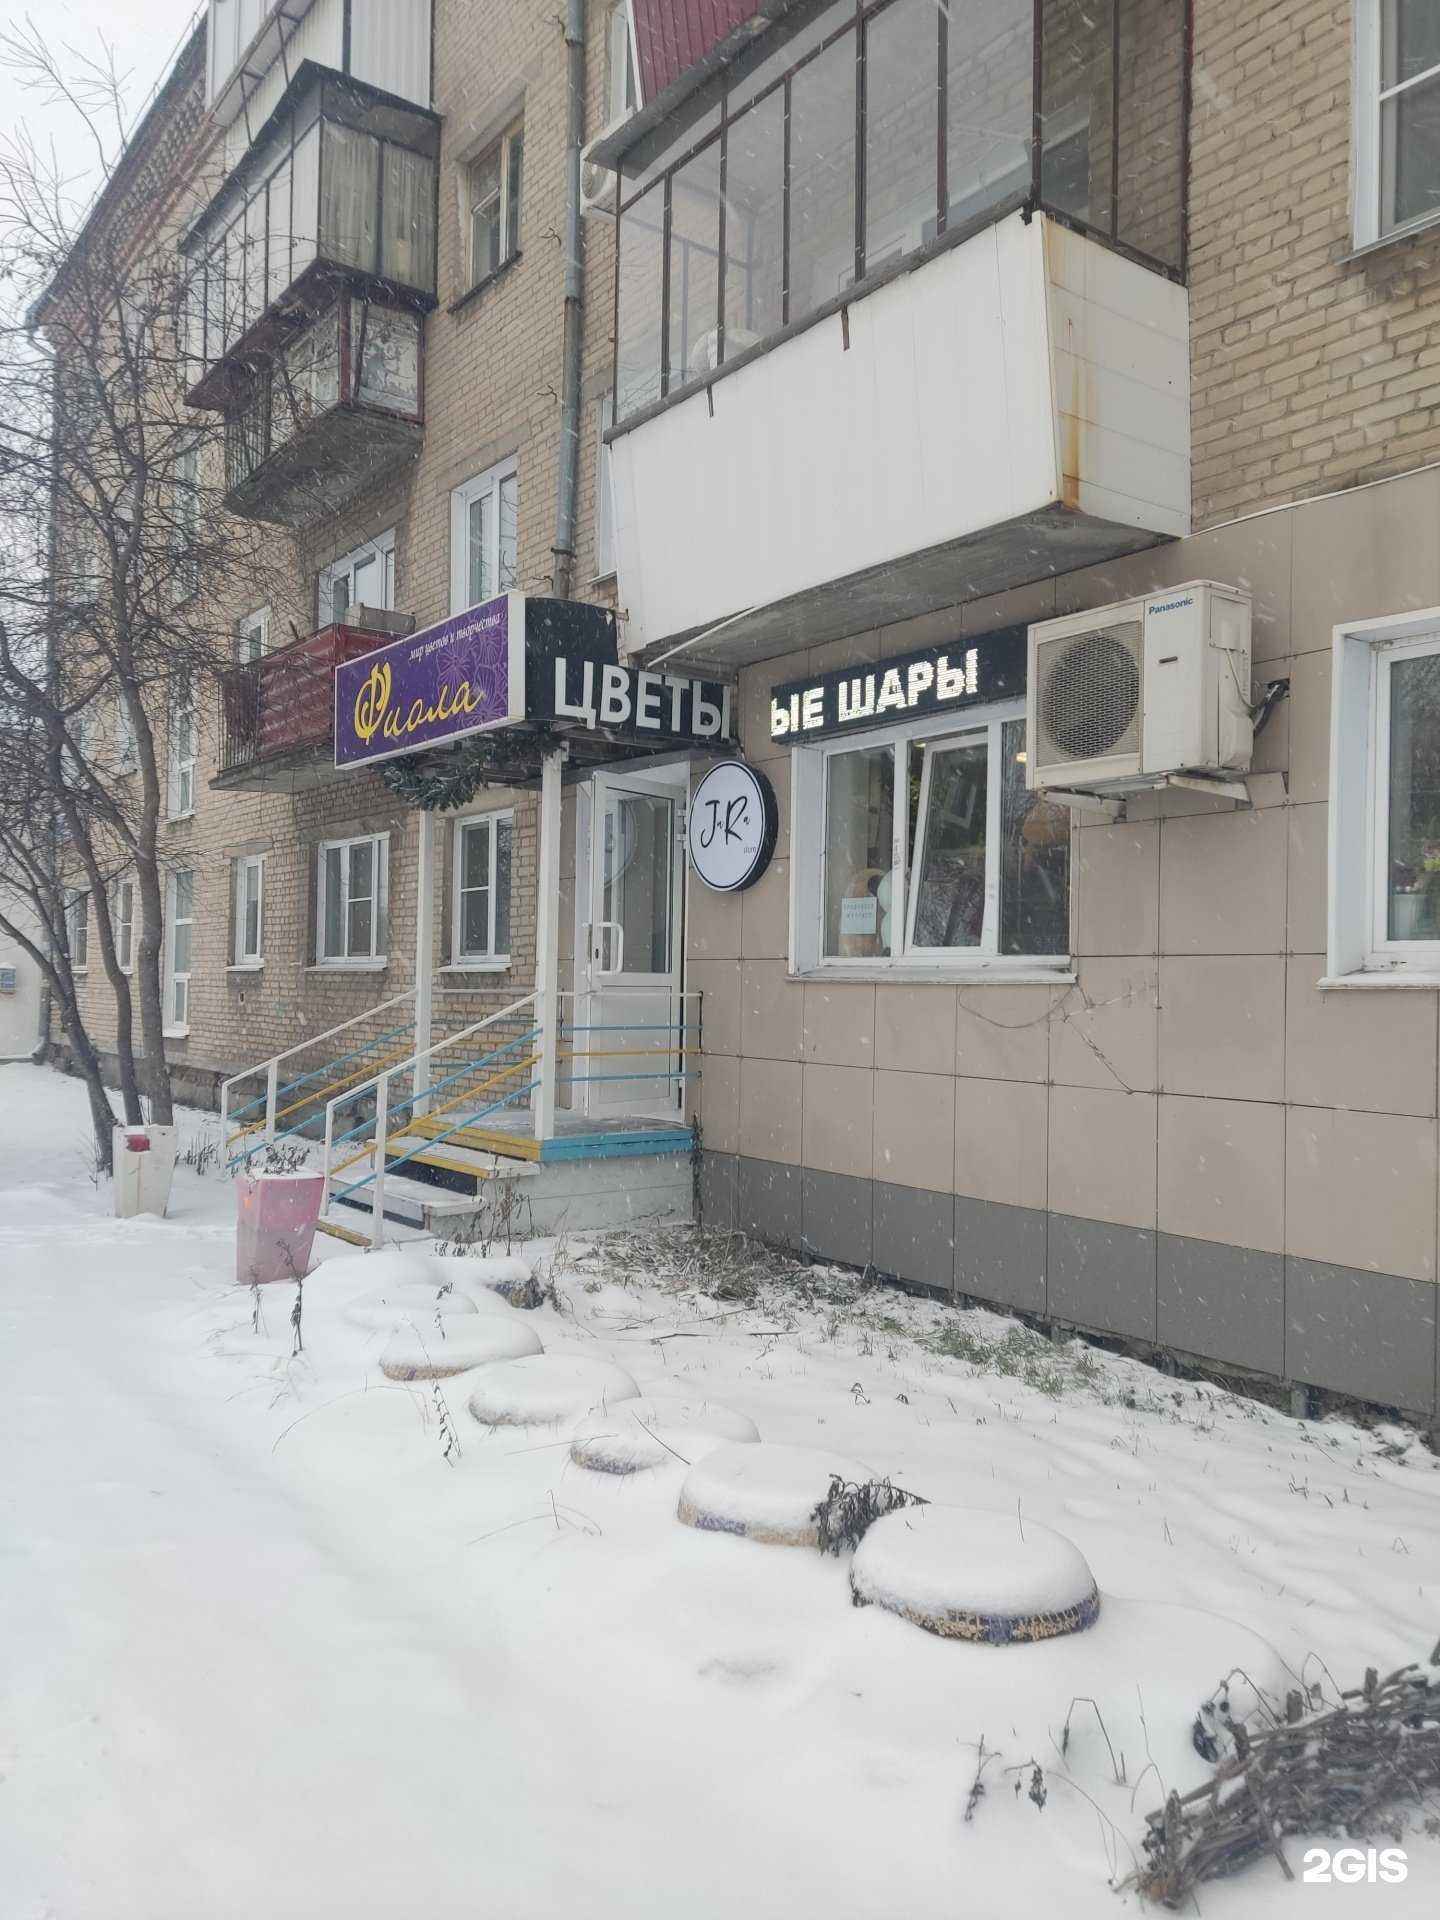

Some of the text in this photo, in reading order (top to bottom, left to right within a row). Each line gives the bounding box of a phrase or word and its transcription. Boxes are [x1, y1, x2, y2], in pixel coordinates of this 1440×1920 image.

[1148, 597, 1194, 614] Panasonic
[409, 613, 503, 663] мир цветов и творчества
[554, 656, 730, 740] ЦВЕТЫ
[838, 648, 979, 722] ШАРЫ
